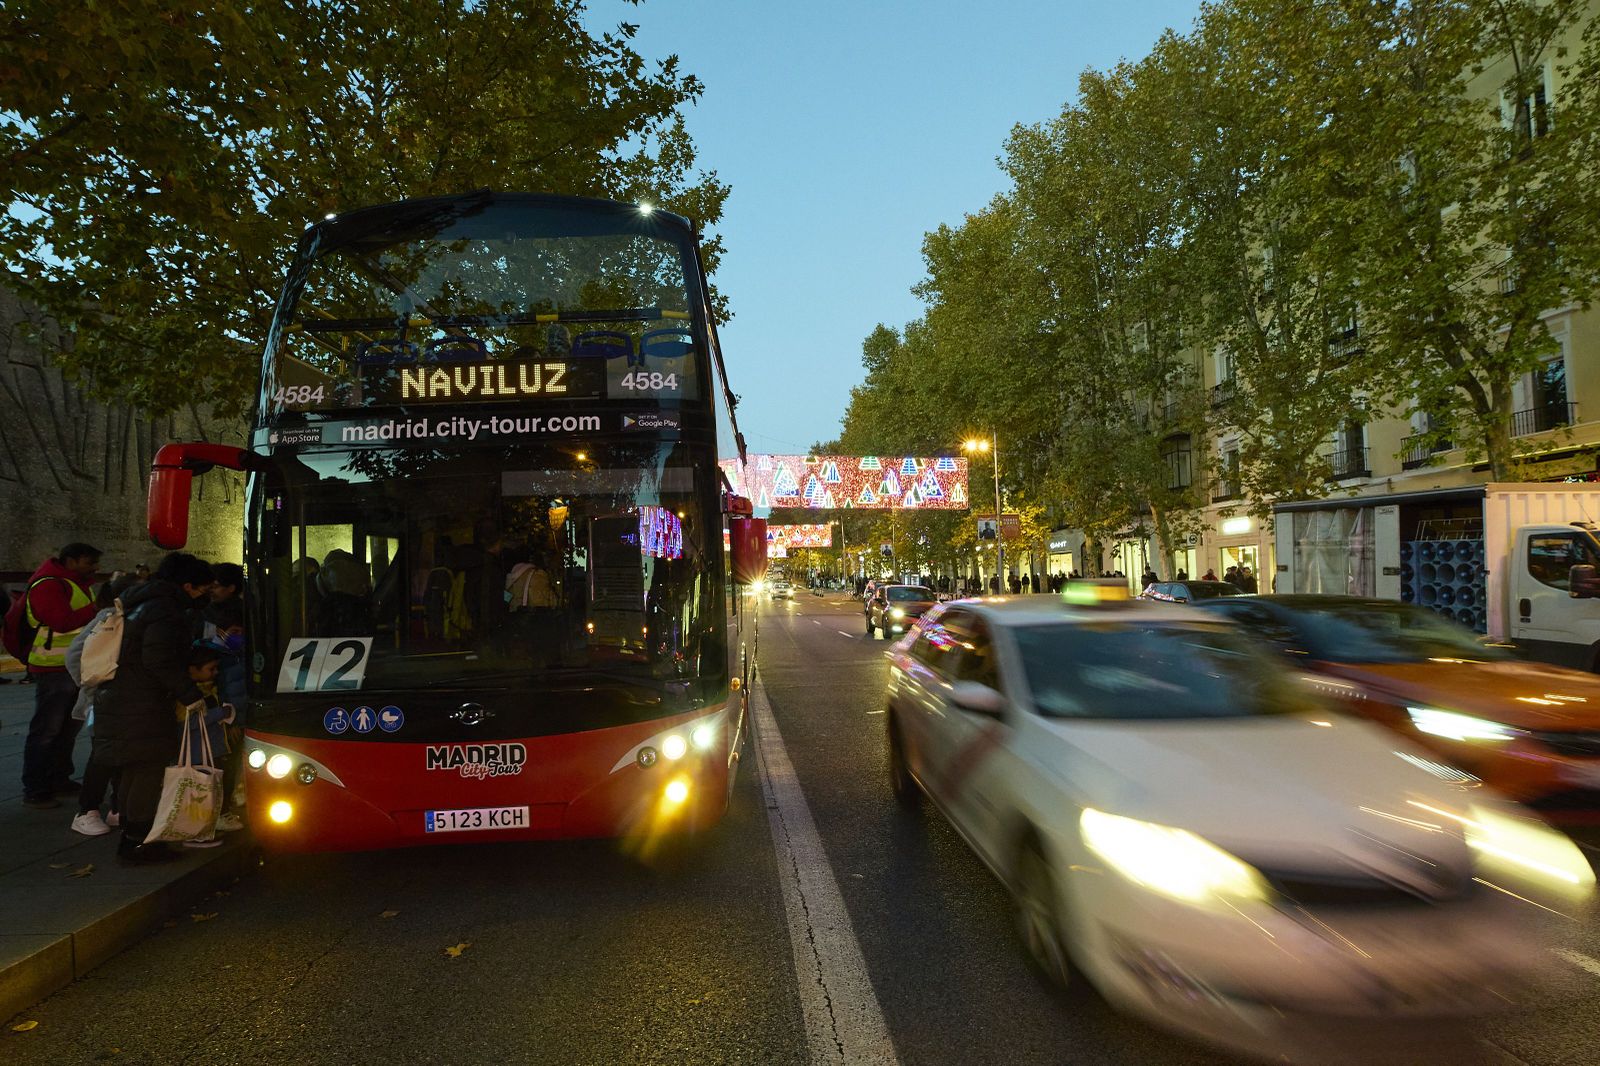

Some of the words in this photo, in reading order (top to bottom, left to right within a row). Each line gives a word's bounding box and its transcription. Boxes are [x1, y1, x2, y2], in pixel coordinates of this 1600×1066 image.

[402, 363, 567, 398] NAVILUZ
[621, 372, 678, 390] 4584
[273, 385, 325, 404] 4584
[342, 415, 601, 441] madrid.city-tour.com
[638, 419, 663, 428] Google
[663, 419, 678, 428] Play
[281, 435, 298, 444] App
[298, 434, 320, 442] Store
[289, 640, 365, 690] 12
[426, 743, 527, 770] MADRID
[460, 762, 488, 780] City
[487, 761, 522, 777] Tour
[436, 811, 482, 829] 5123
[489, 809, 523, 827] KCH
